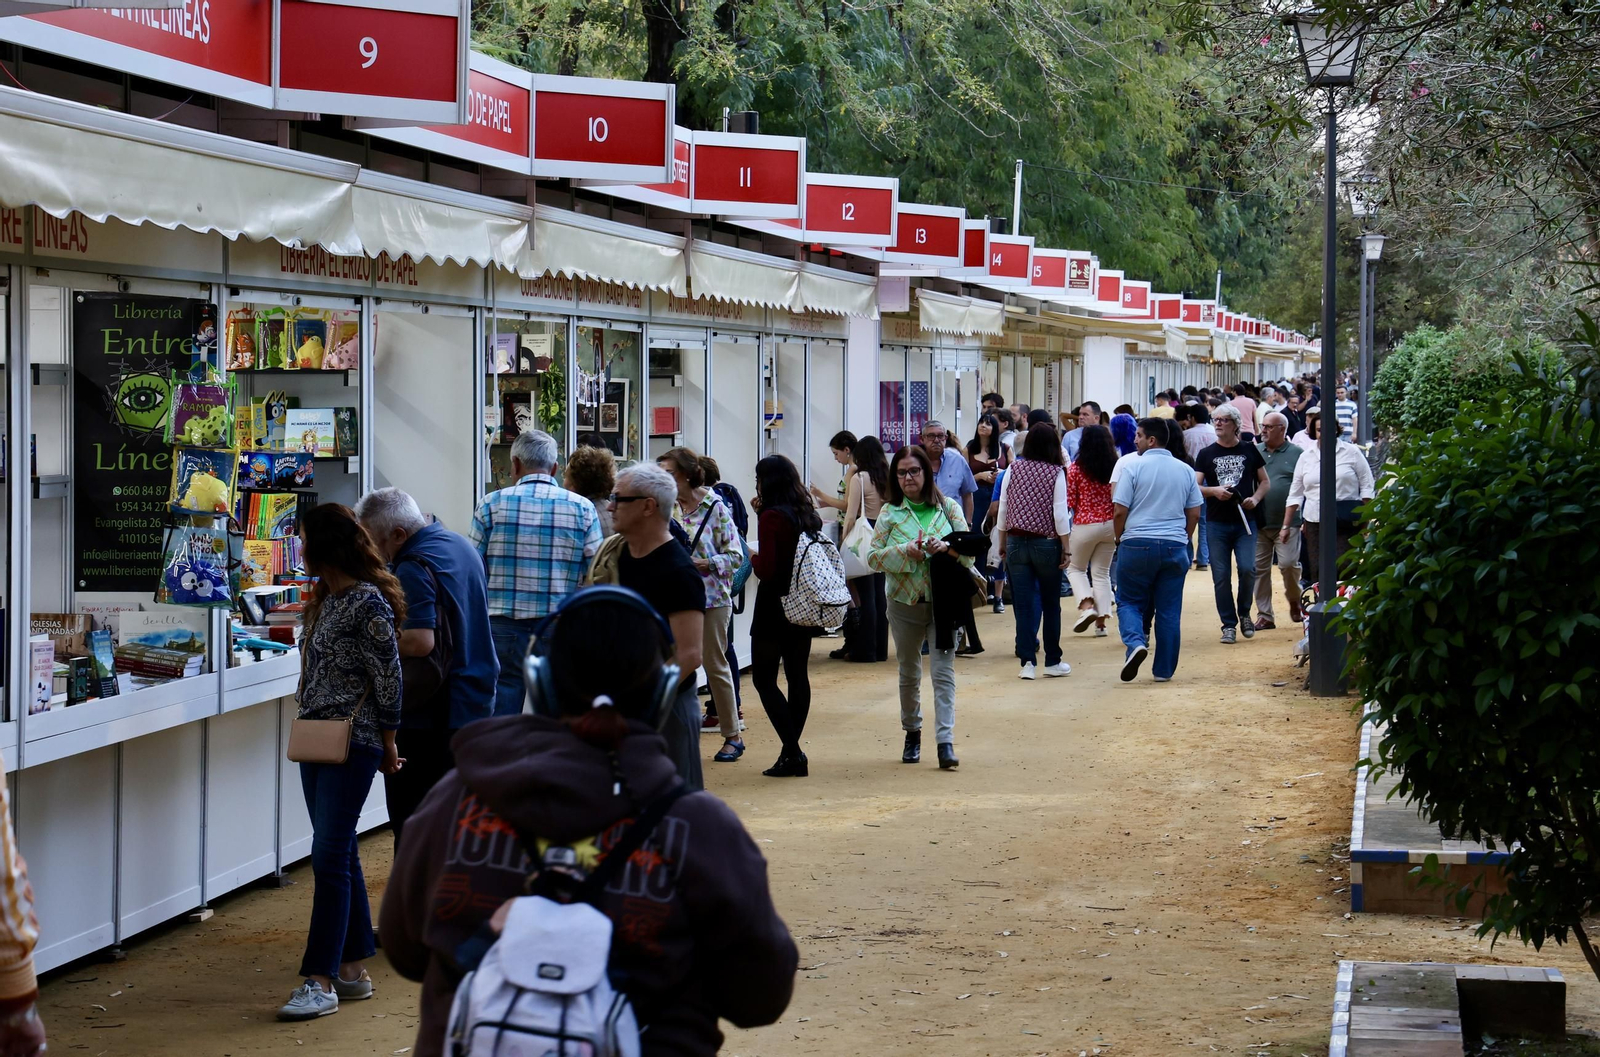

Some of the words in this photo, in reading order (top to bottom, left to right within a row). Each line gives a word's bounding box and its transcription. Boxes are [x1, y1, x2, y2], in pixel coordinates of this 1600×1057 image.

[162, 0, 210, 44] LINEAS
[358, 36, 378, 69] 9
[475, 92, 487, 126] DE
[488, 97, 512, 134] PAPEL
[588, 116, 609, 142] 10
[739, 166, 751, 188] 11
[842, 202, 855, 221] 12
[34, 205, 88, 253] LINEAS
[915, 227, 927, 244] 13
[280, 244, 327, 276] LIBRERIA
[342, 252, 371, 281] ERIZO
[376, 250, 389, 283] DE
[391, 252, 418, 286] PAPEL
[992, 252, 1002, 267] 14
[1033, 265, 1042, 278] 15
[113, 301, 183, 319] Librería
[100, 328, 194, 355] Entre
[93, 443, 173, 471] Líne
[122, 485, 140, 496] 660
[142, 485, 154, 496] 84
[155, 485, 168, 496] 87
[121, 502, 139, 512] 954
[141, 502, 153, 512] 34
[155, 502, 167, 512] 27
[95, 517, 148, 530] Evangelista
[149, 517, 161, 528] 26
[119, 533, 147, 544] 41010
[30, 620, 62, 628] IGLESIAS
